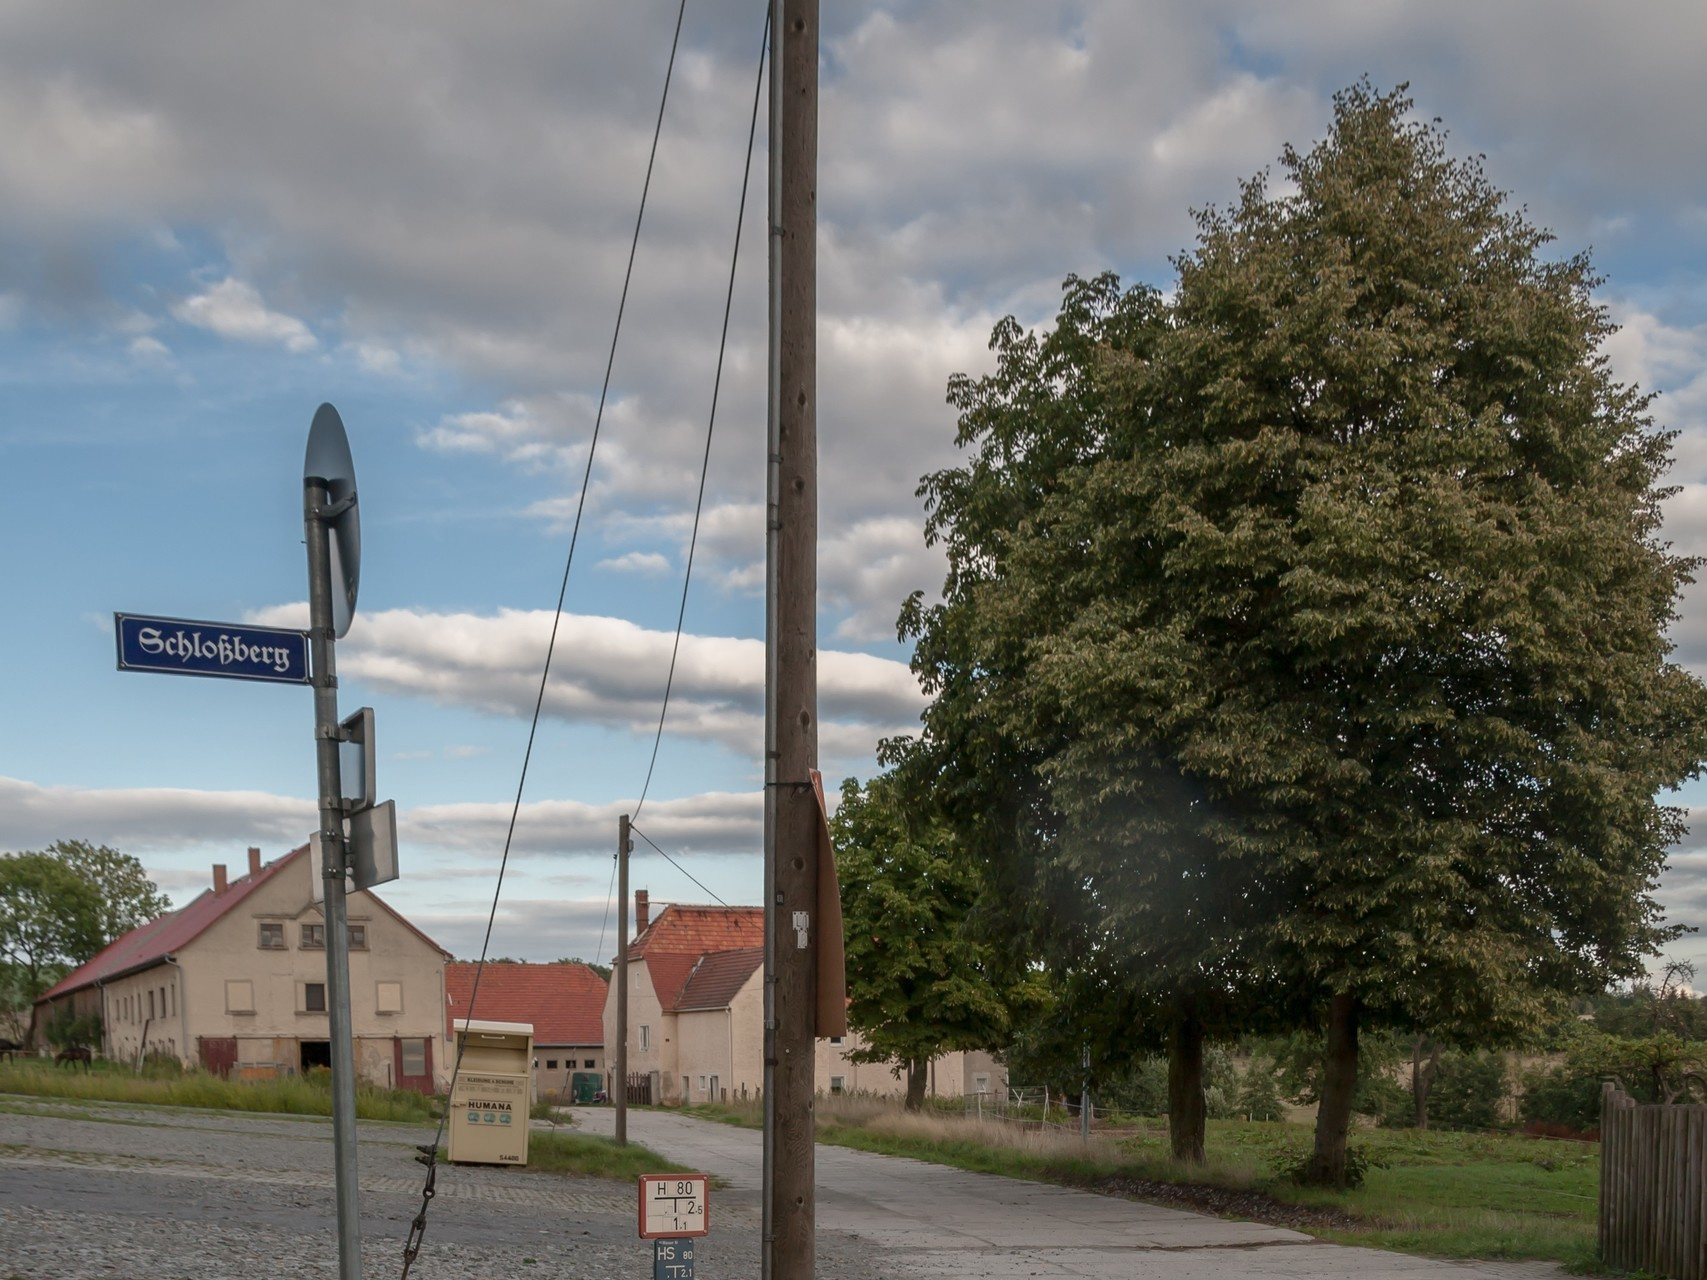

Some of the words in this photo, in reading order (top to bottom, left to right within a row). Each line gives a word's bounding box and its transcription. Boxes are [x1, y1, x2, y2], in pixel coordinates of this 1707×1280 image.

[138, 627, 290, 672] Schloßberg
[468, 1101, 512, 1111] HUMANA
[657, 1181, 666, 1195] H
[677, 1181, 693, 1195] 80
[657, 1246, 675, 1261] HS
[682, 1250, 693, 1260] 80
